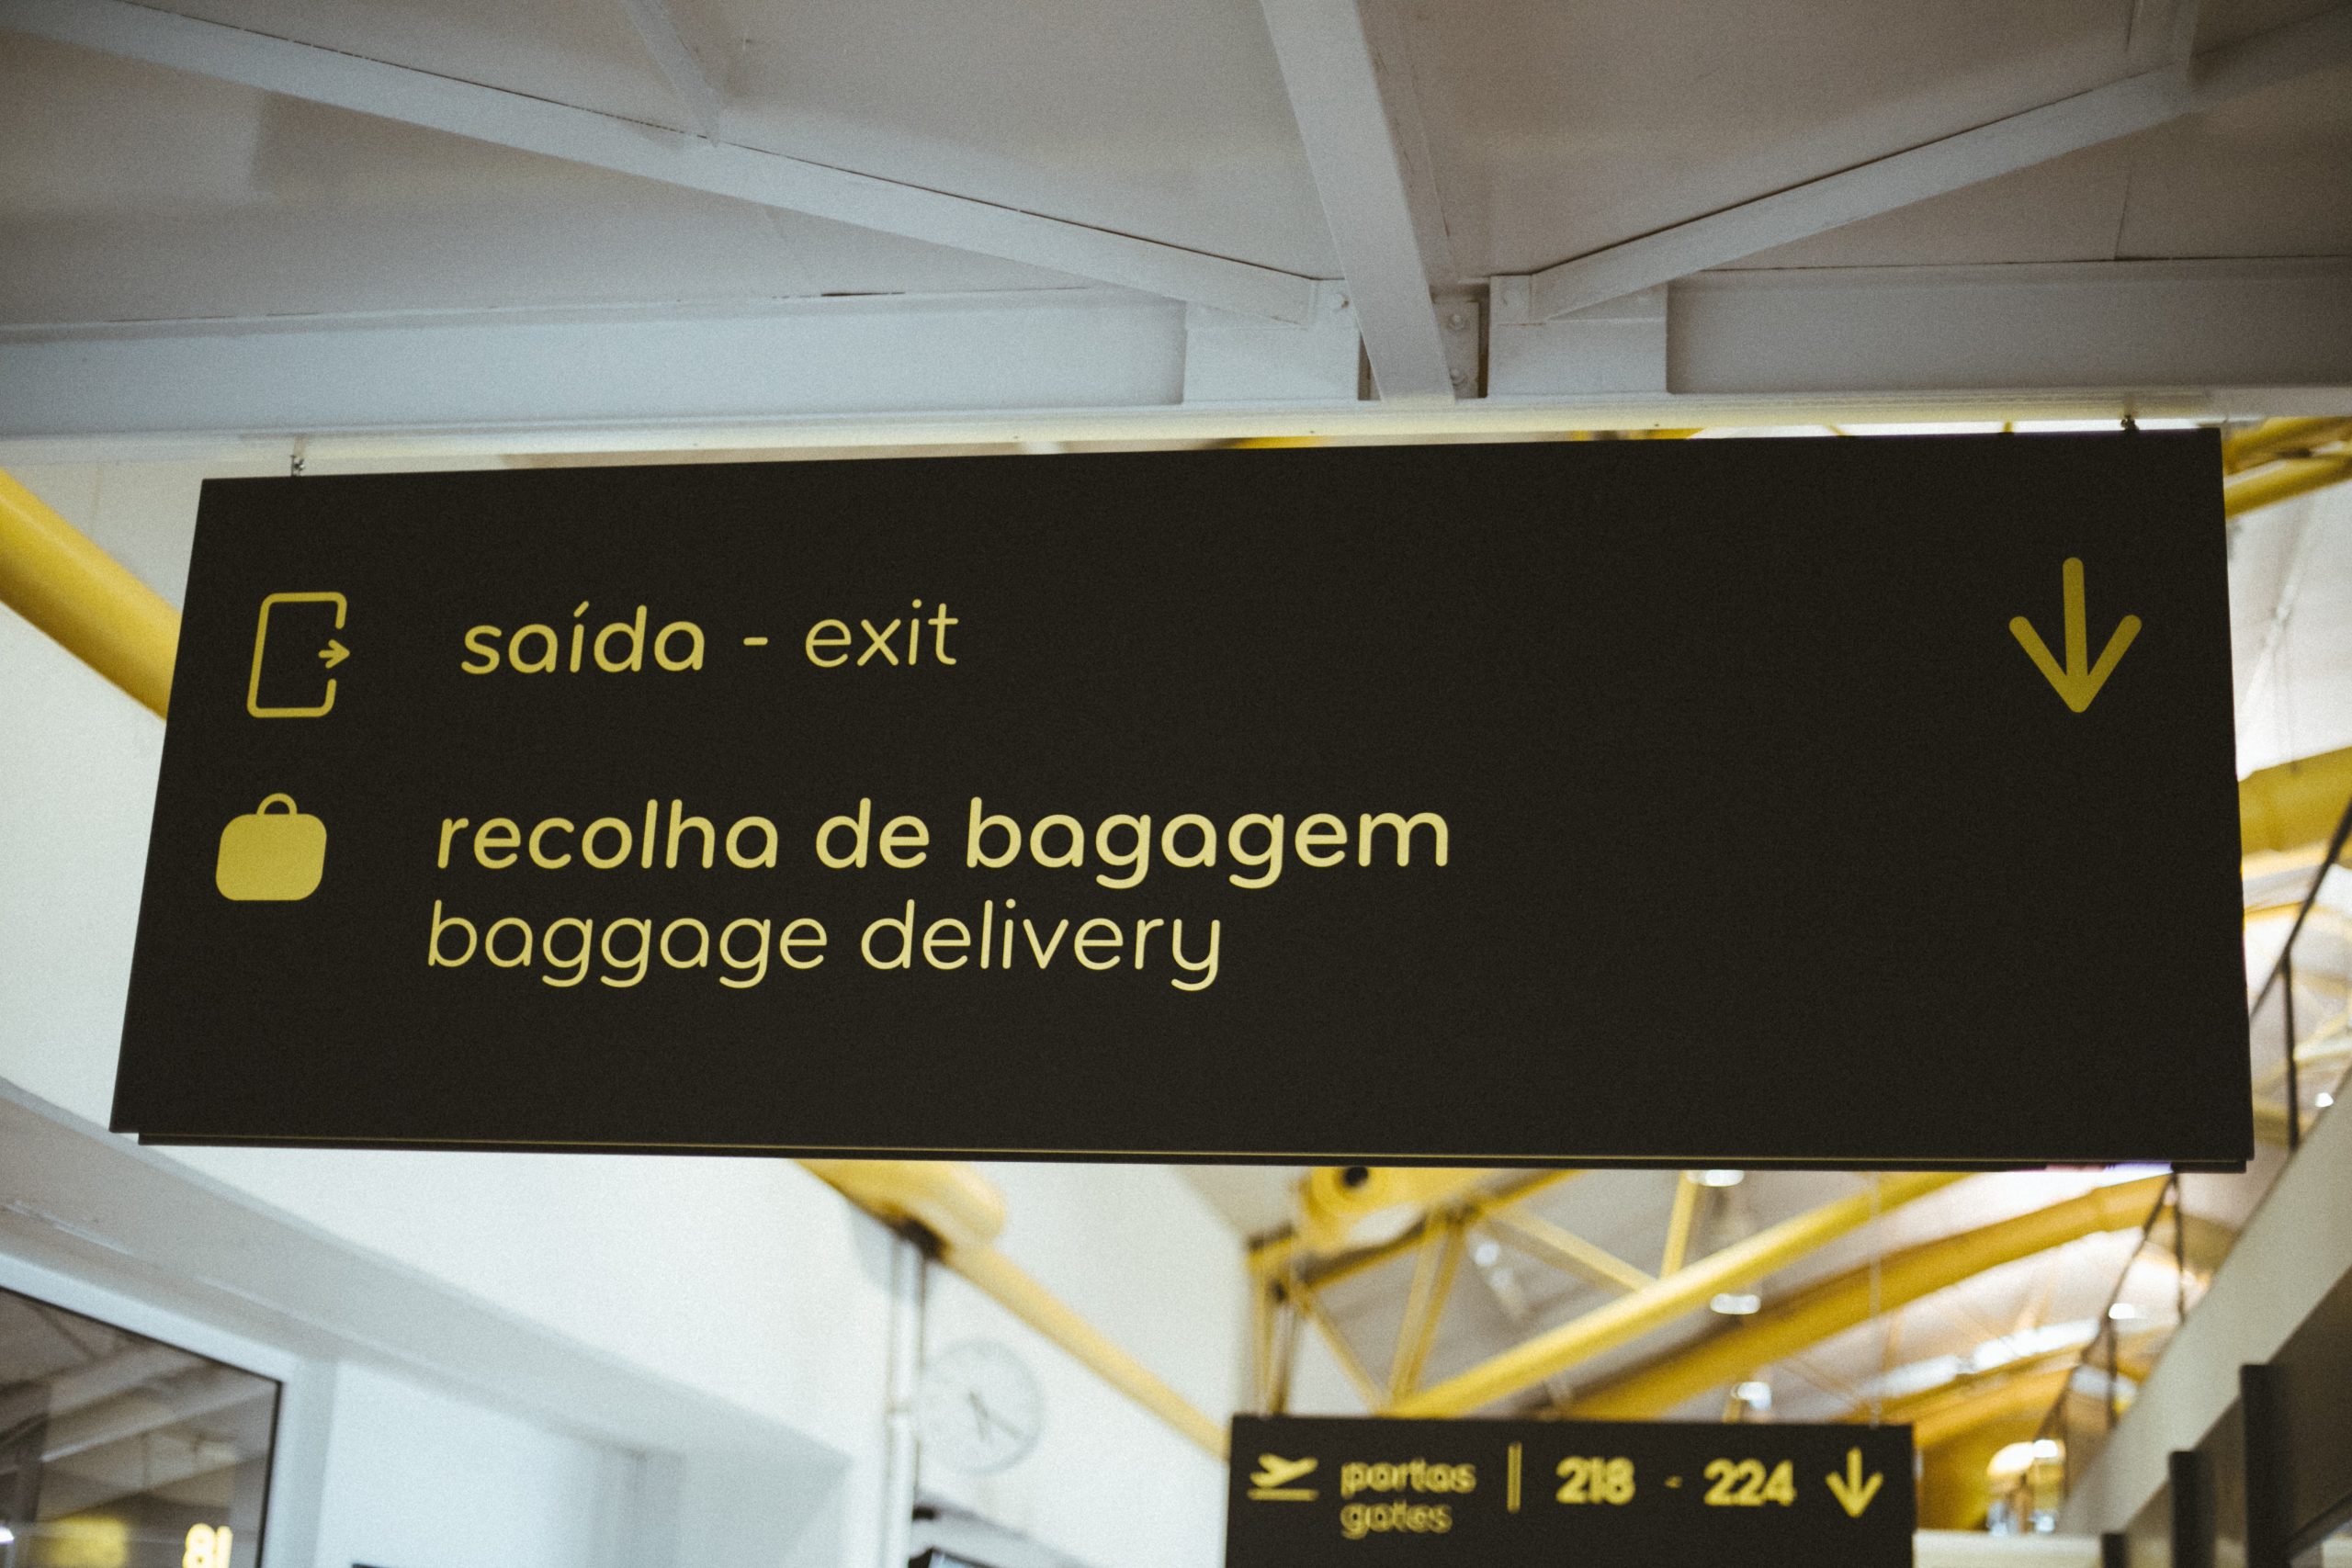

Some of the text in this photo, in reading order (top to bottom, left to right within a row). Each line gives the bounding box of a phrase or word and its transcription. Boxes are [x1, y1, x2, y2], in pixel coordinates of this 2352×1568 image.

[460, 601, 706, 675] saída
[804, 598, 960, 669] exit
[436, 795, 1450, 890] recolha de bagagem
[426, 897, 1222, 993] baggage delivery
[1339, 1499, 1453, 1540] gates
[1340, 1457, 1477, 1499] portas
[1555, 1455, 1637, 1506] 218
[1702, 1457, 1798, 1507] 224
